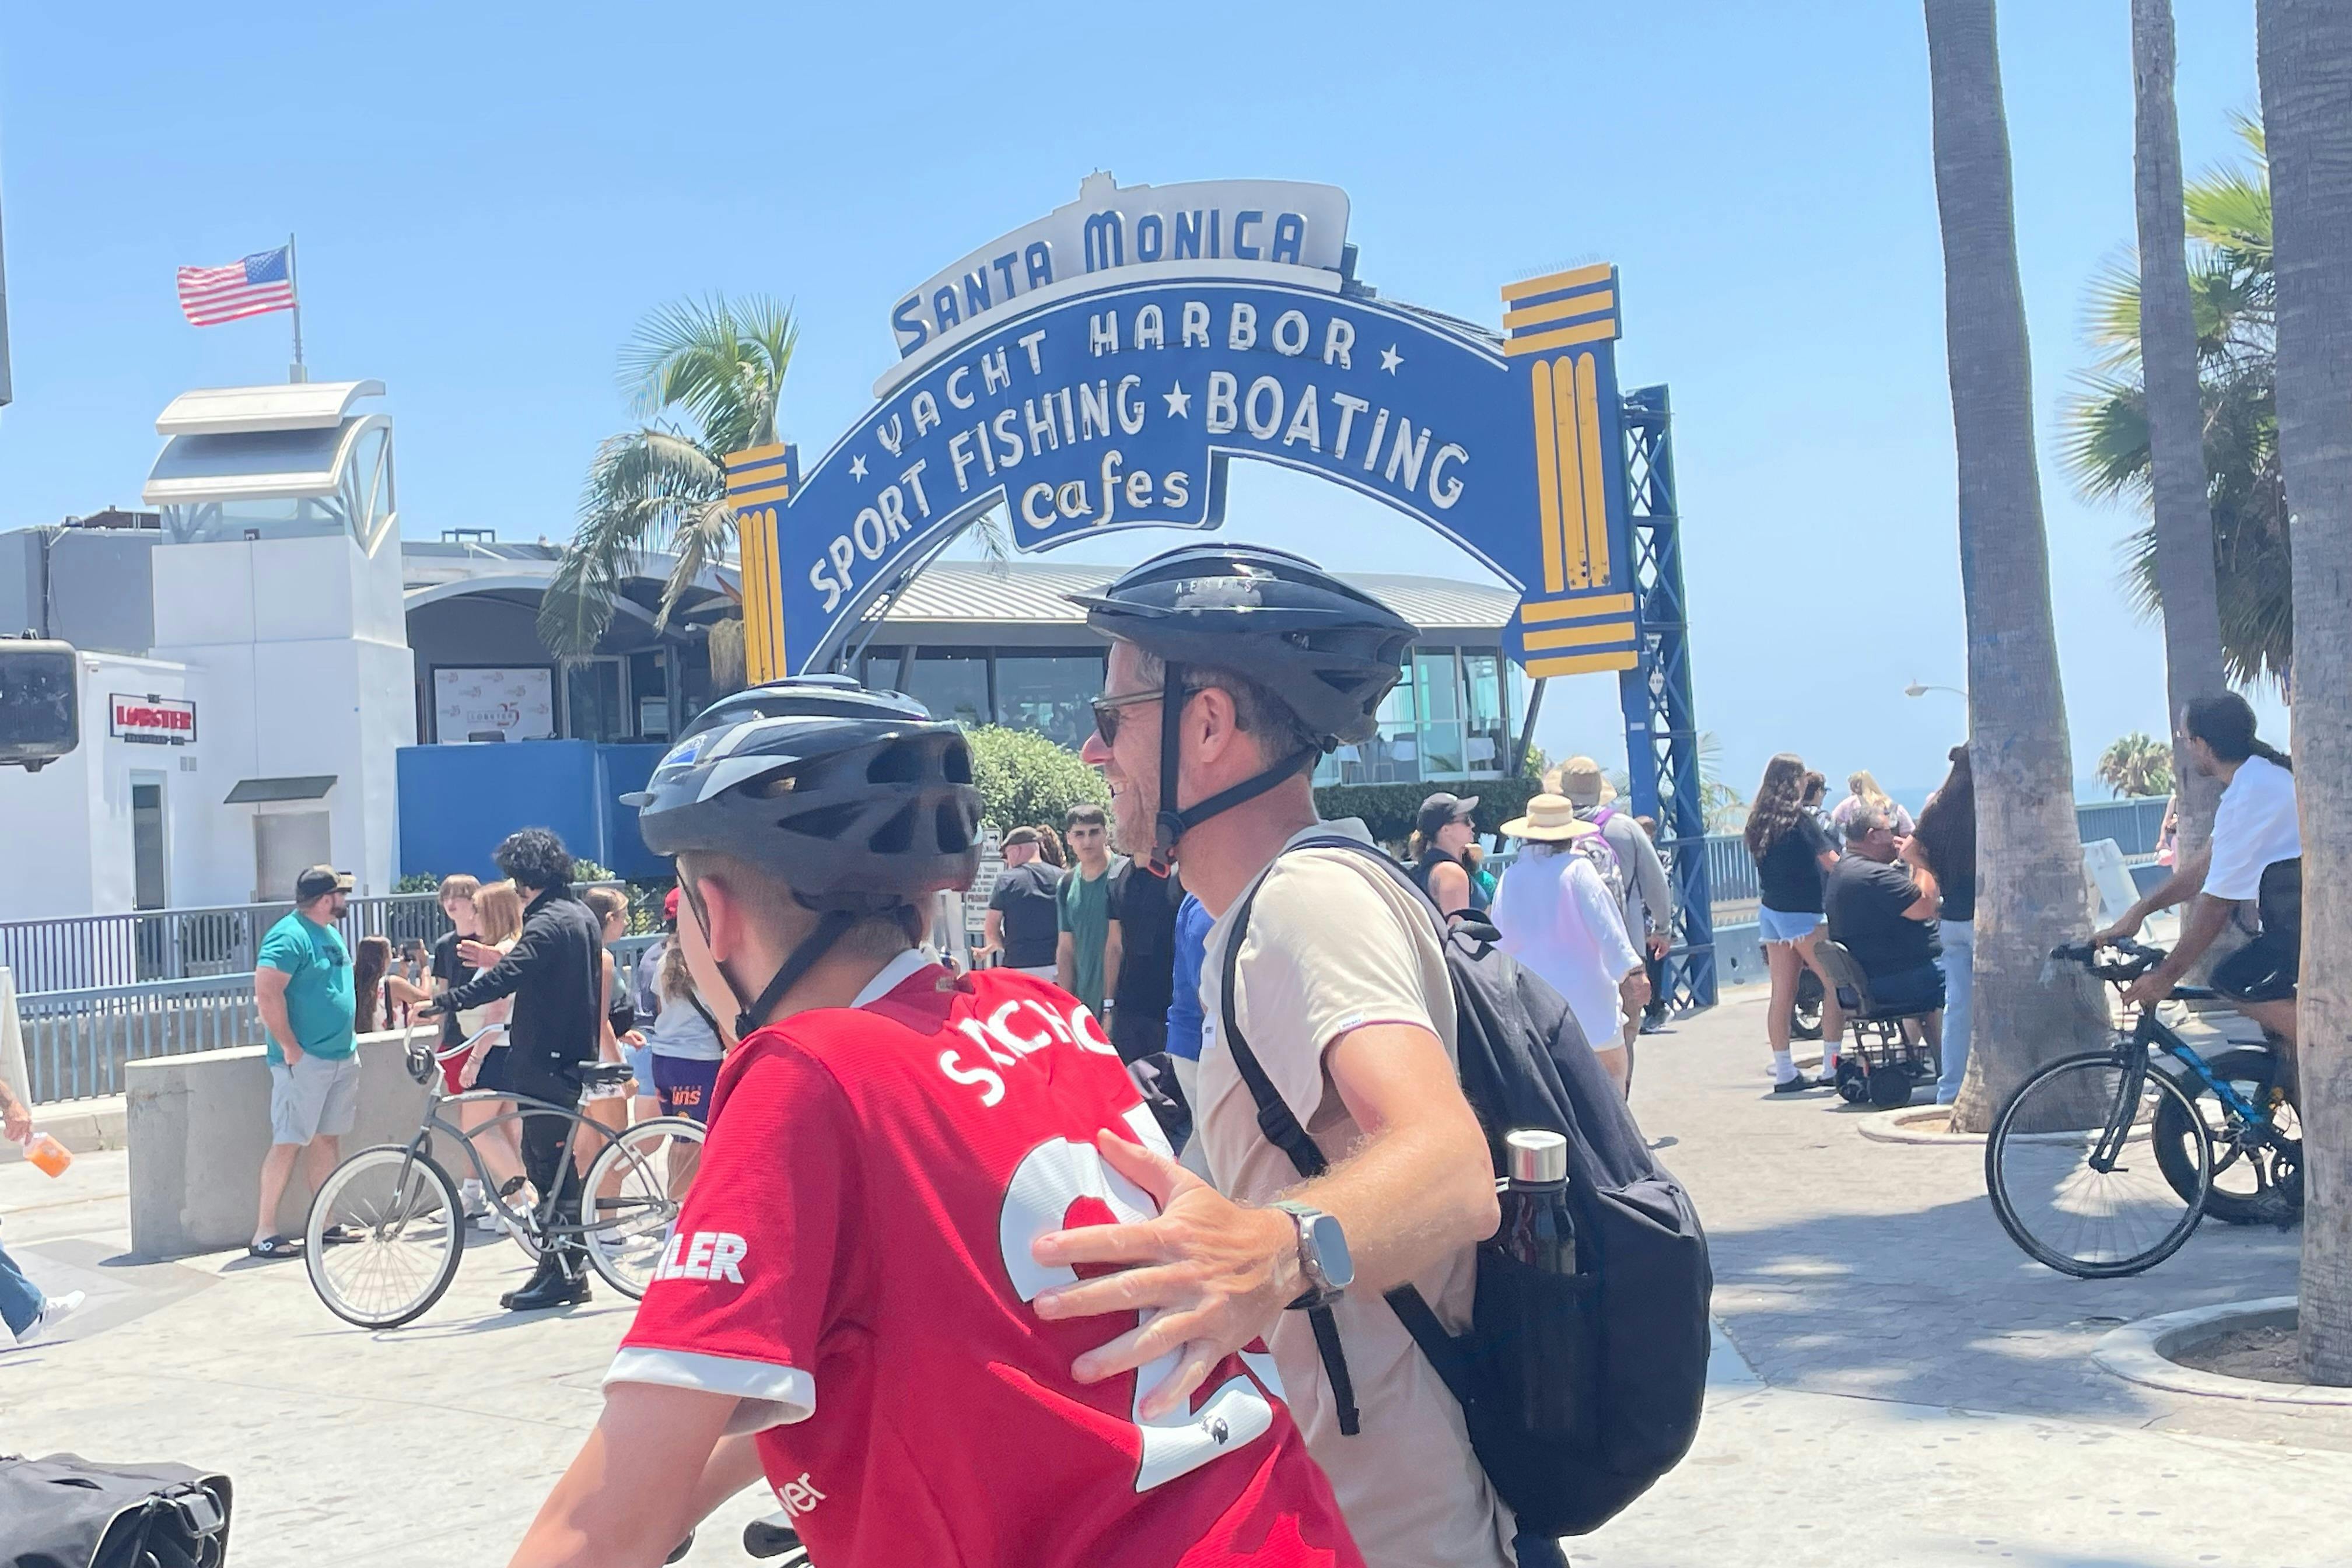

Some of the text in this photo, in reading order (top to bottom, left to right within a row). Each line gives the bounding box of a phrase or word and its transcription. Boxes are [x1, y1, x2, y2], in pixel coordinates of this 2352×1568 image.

[893, 209, 1307, 360] SANTA MONICA
[876, 300, 1356, 458] YACHT HARBOR
[809, 370, 1469, 614] SPORT FISHING BOATING
[1021, 449, 1189, 530] cafes
[116, 705, 192, 730] LOBSTER
[939, 999, 1119, 1108] SACHO
